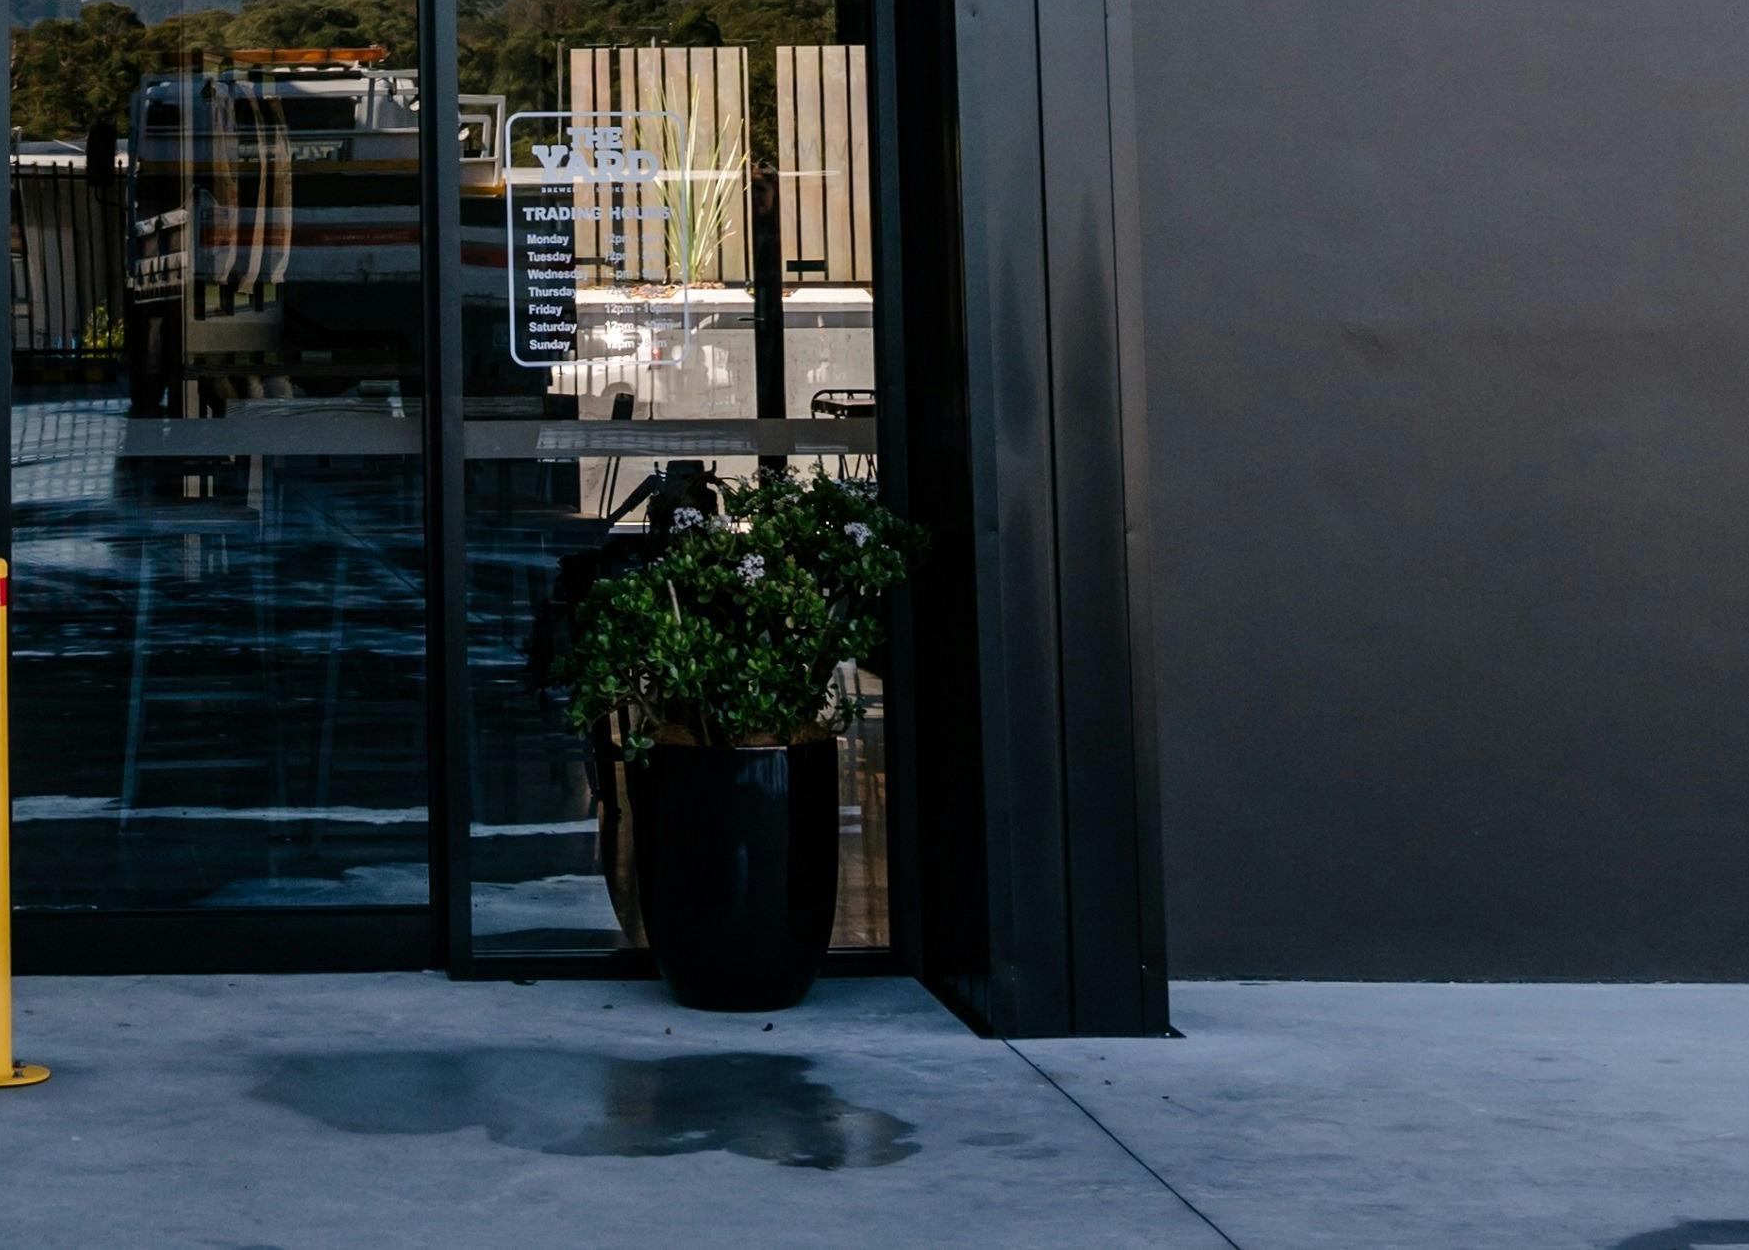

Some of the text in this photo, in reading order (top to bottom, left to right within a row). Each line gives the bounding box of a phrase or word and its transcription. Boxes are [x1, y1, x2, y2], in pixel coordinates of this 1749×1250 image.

[566, 126, 623, 149] THE
[531, 144, 658, 184] YARD
[522, 206, 601, 222] TRADING
[526, 234, 569, 247] Monday
[527, 251, 572, 264] Tuesday
[527, 269, 589, 281] Wednesday
[528, 286, 577, 299] Thursday
[528, 304, 563, 317] Friday
[604, 304, 634, 316] 12pm
[528, 322, 578, 334] Saturday
[604, 320, 635, 334] 12pm
[529, 339, 570, 351] Sunday
